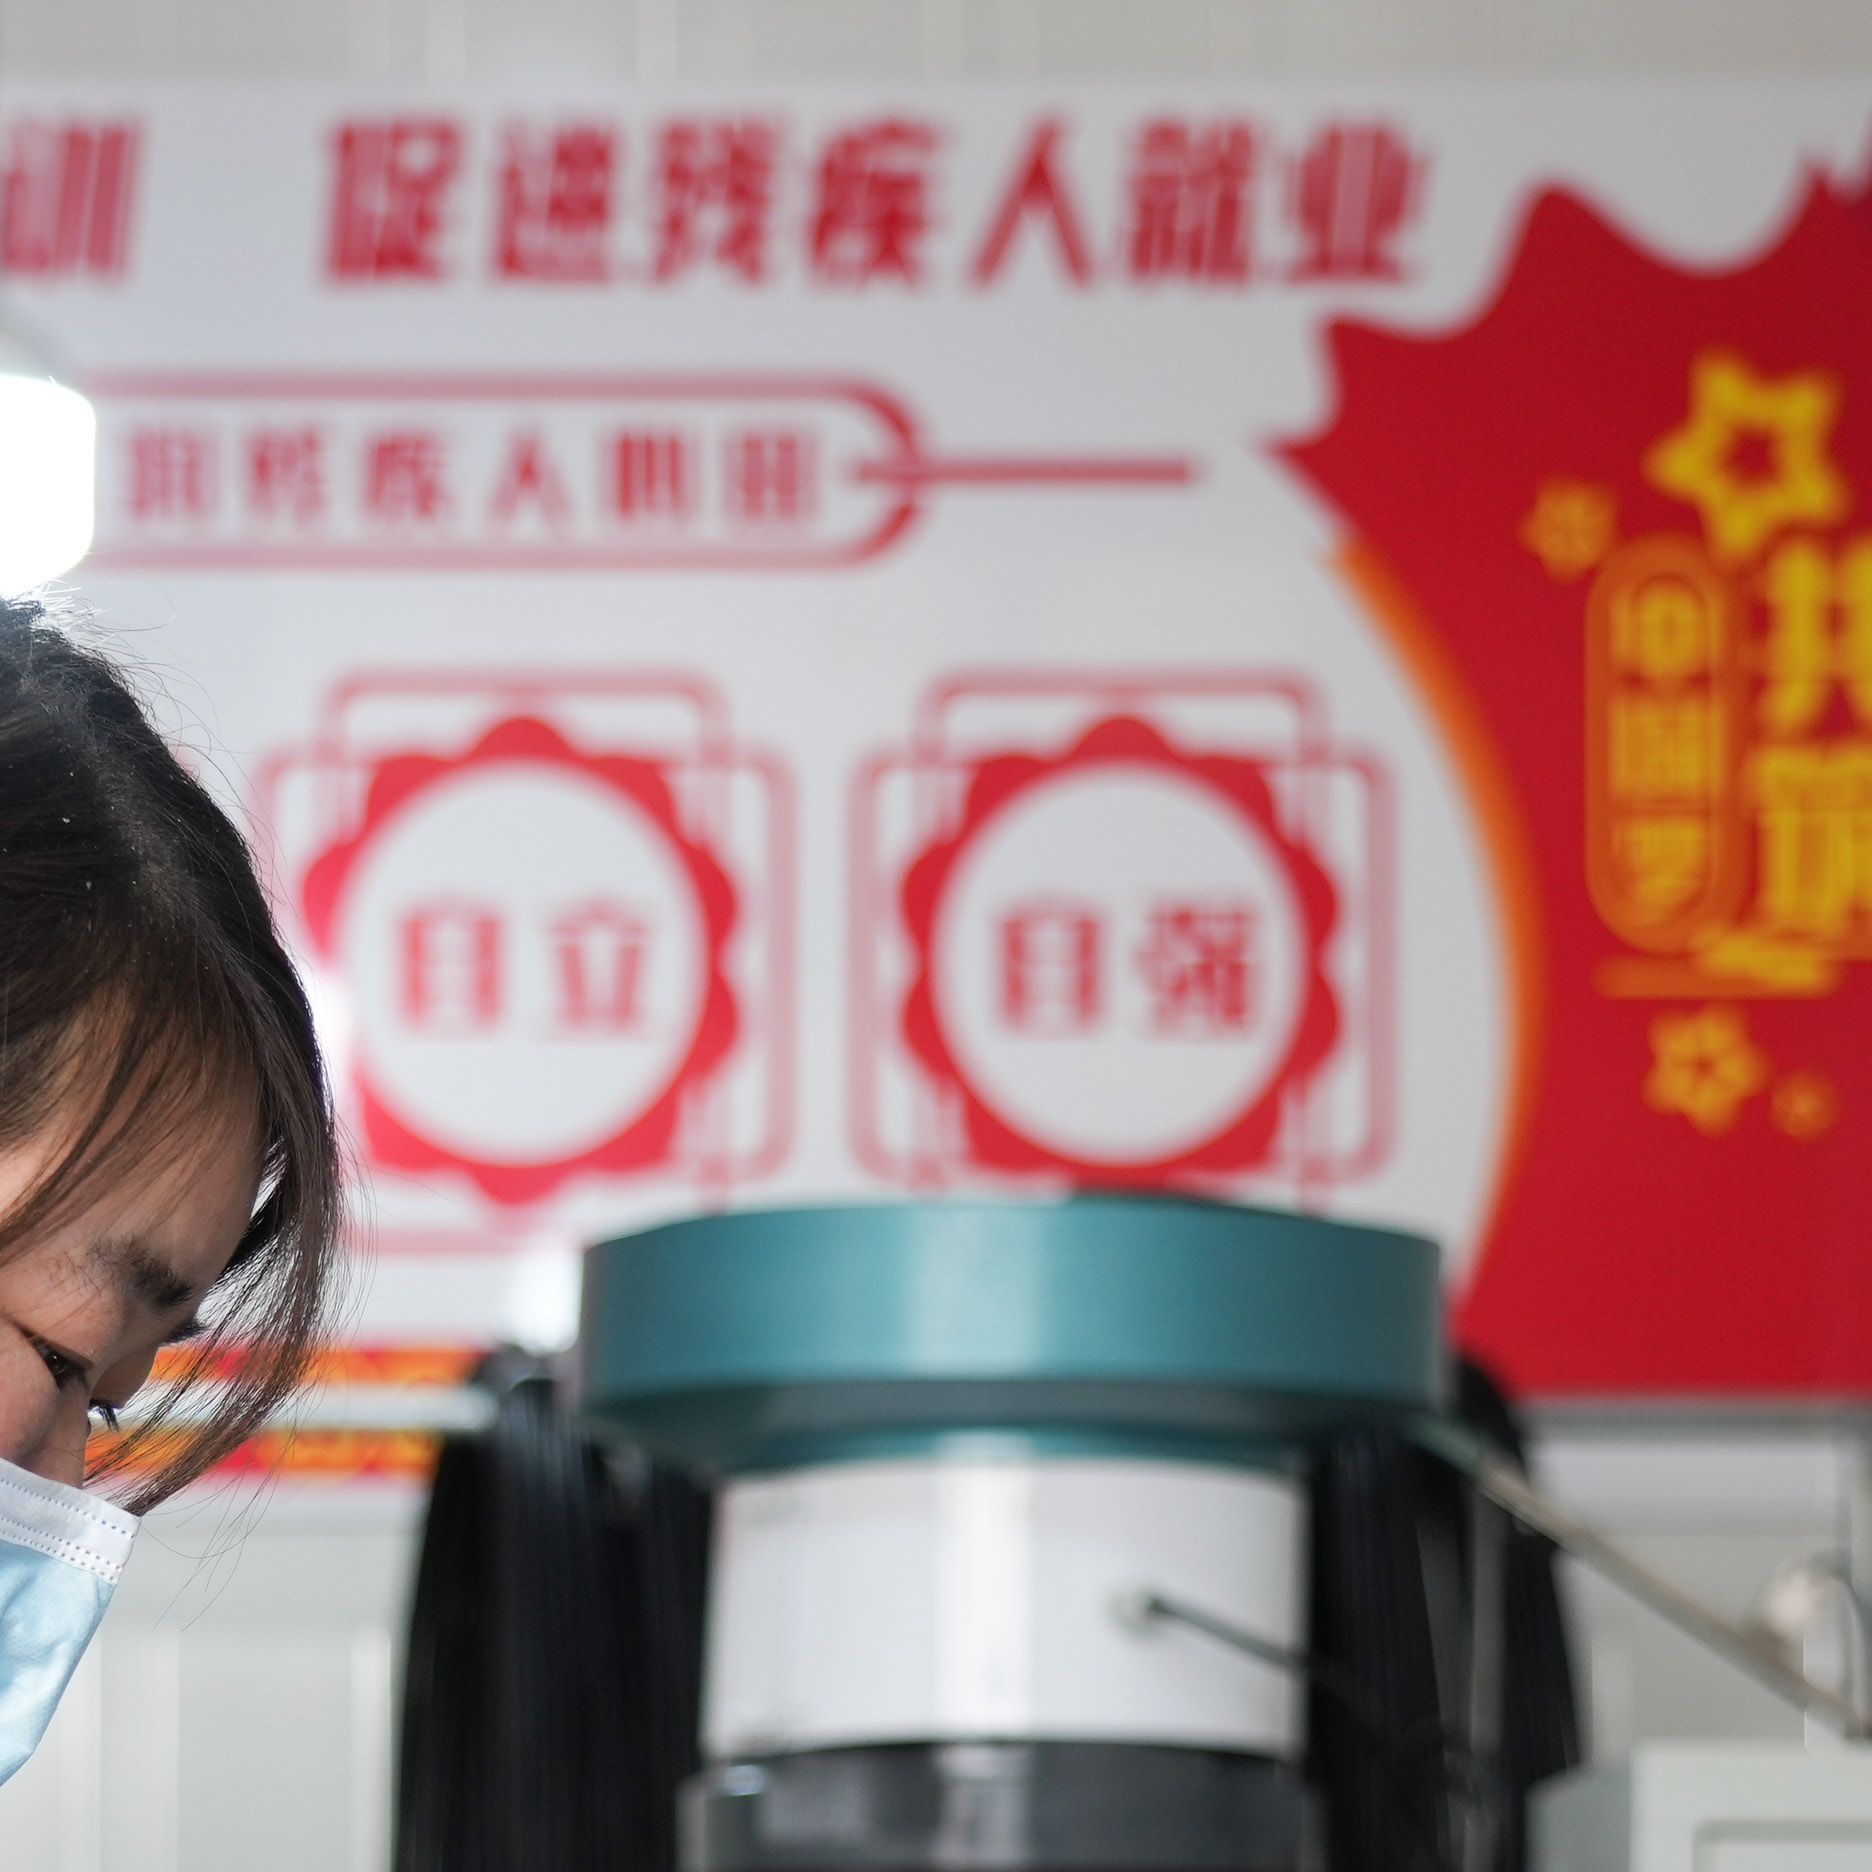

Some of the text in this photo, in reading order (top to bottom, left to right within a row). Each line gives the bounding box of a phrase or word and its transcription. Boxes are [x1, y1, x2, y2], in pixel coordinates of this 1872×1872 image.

[318, 112, 1431, 284] 促进残疾人就业
[397, 896, 654, 1034] 自立
[994, 896, 1256, 1034] 自强
